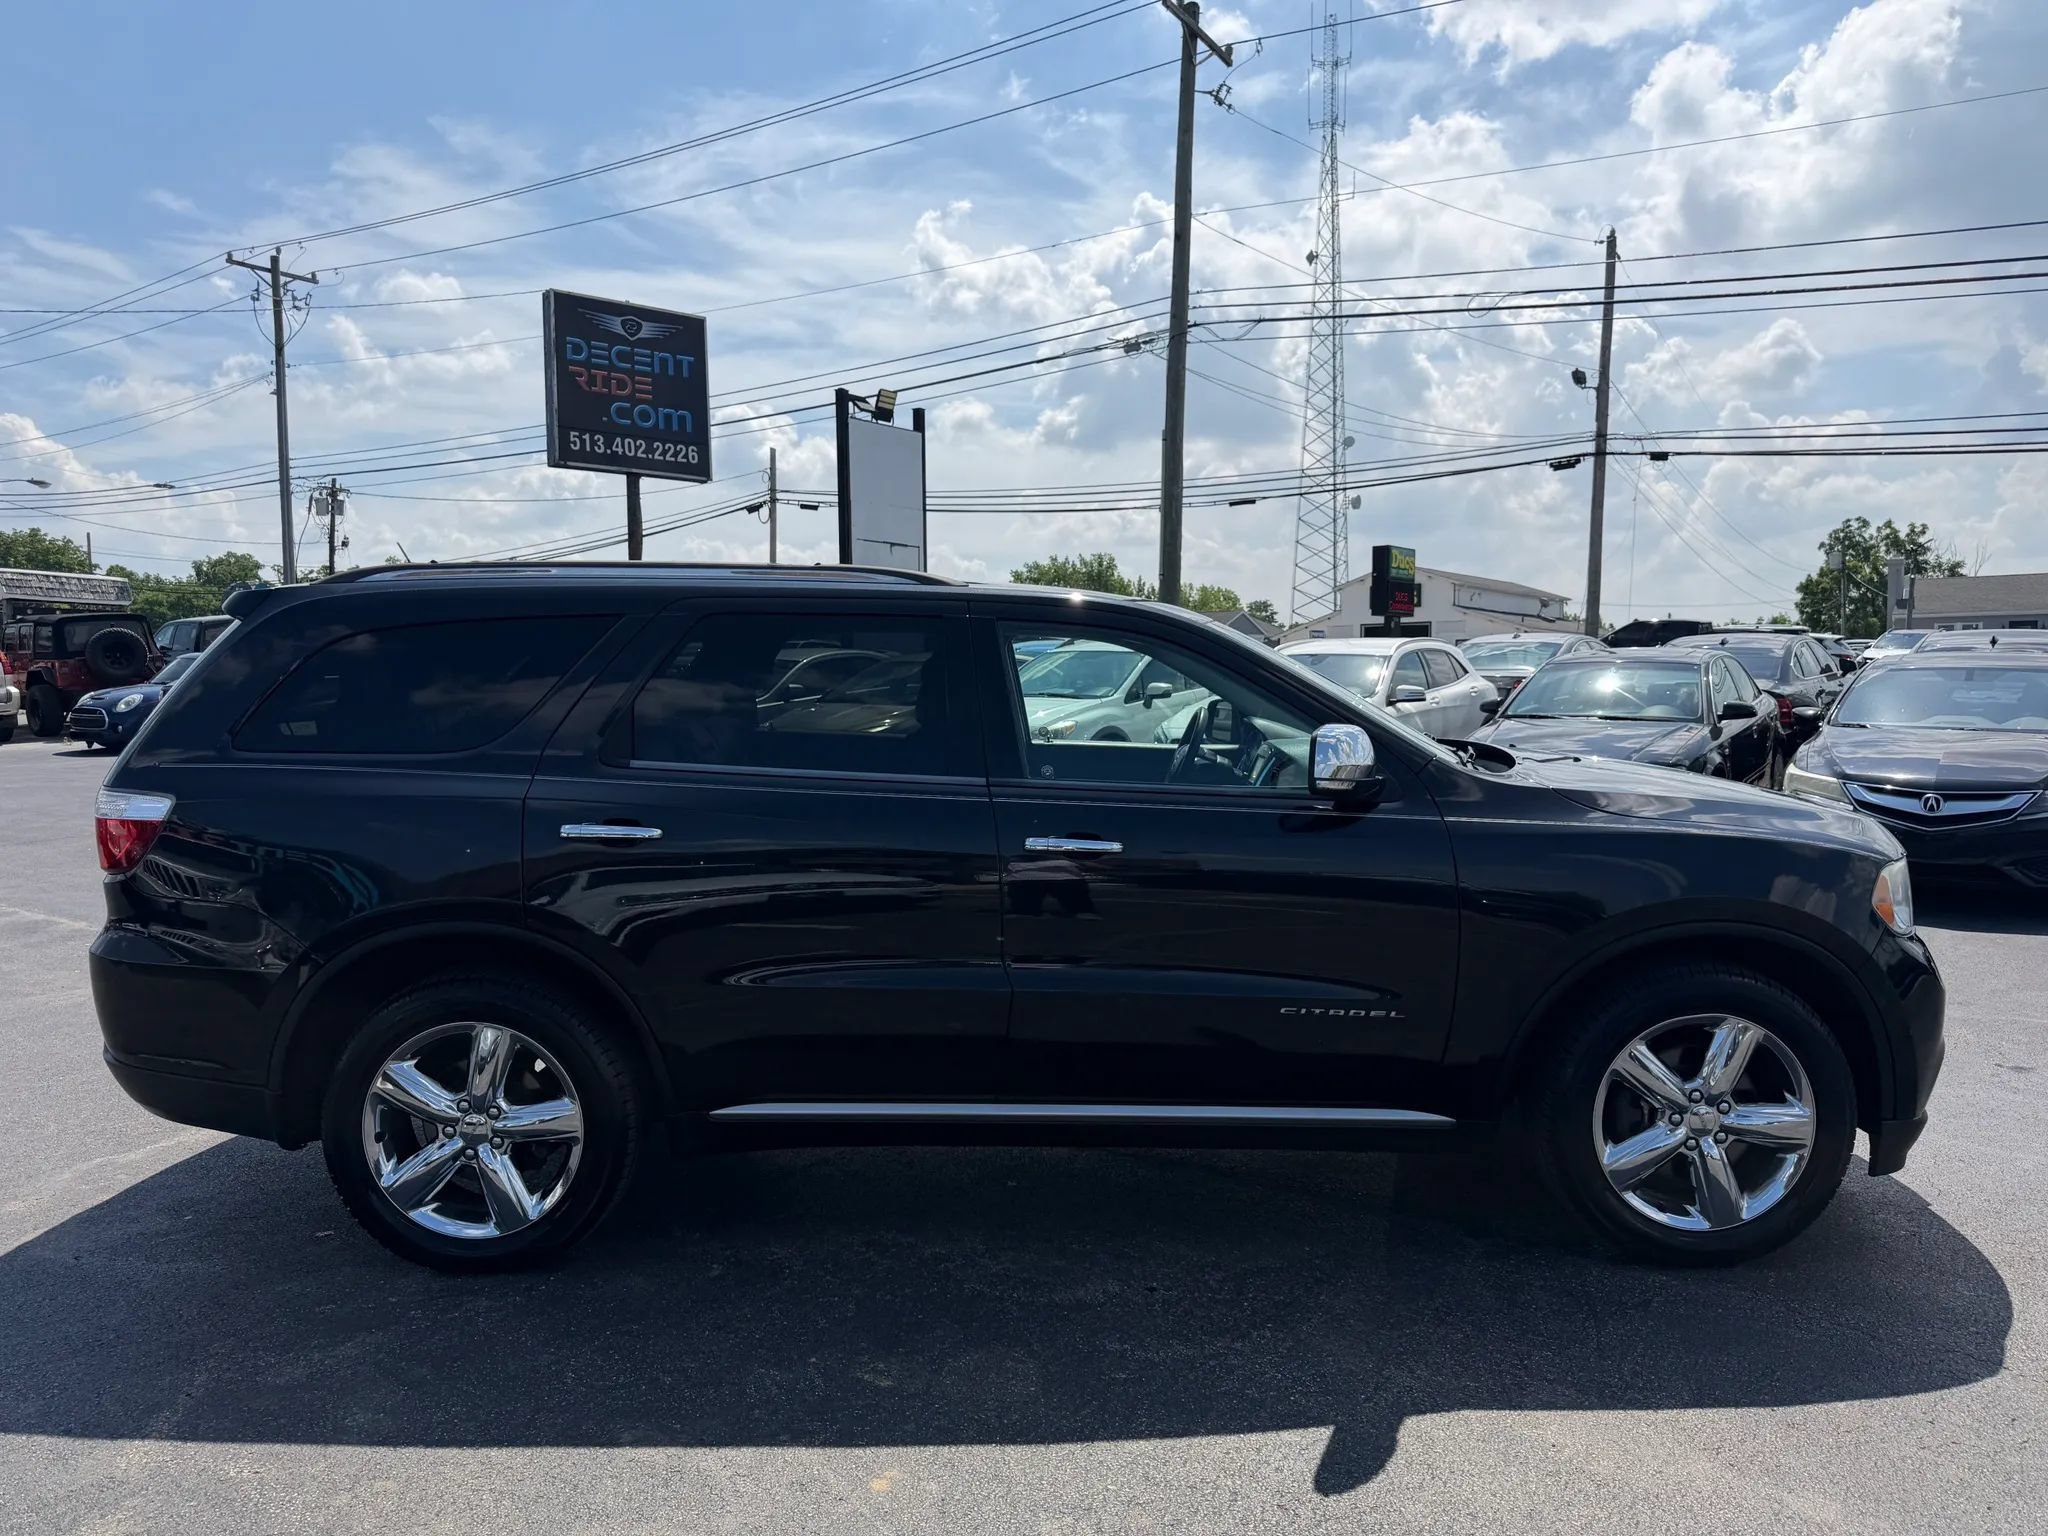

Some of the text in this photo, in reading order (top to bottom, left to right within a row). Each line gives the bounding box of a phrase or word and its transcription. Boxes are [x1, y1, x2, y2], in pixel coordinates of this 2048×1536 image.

[566, 336, 695, 378] DECENT
[568, 366, 653, 400] RIDE
[569, 431, 699, 464] 513.402.2226
[1280, 1007, 1406, 1018] CITADEL
